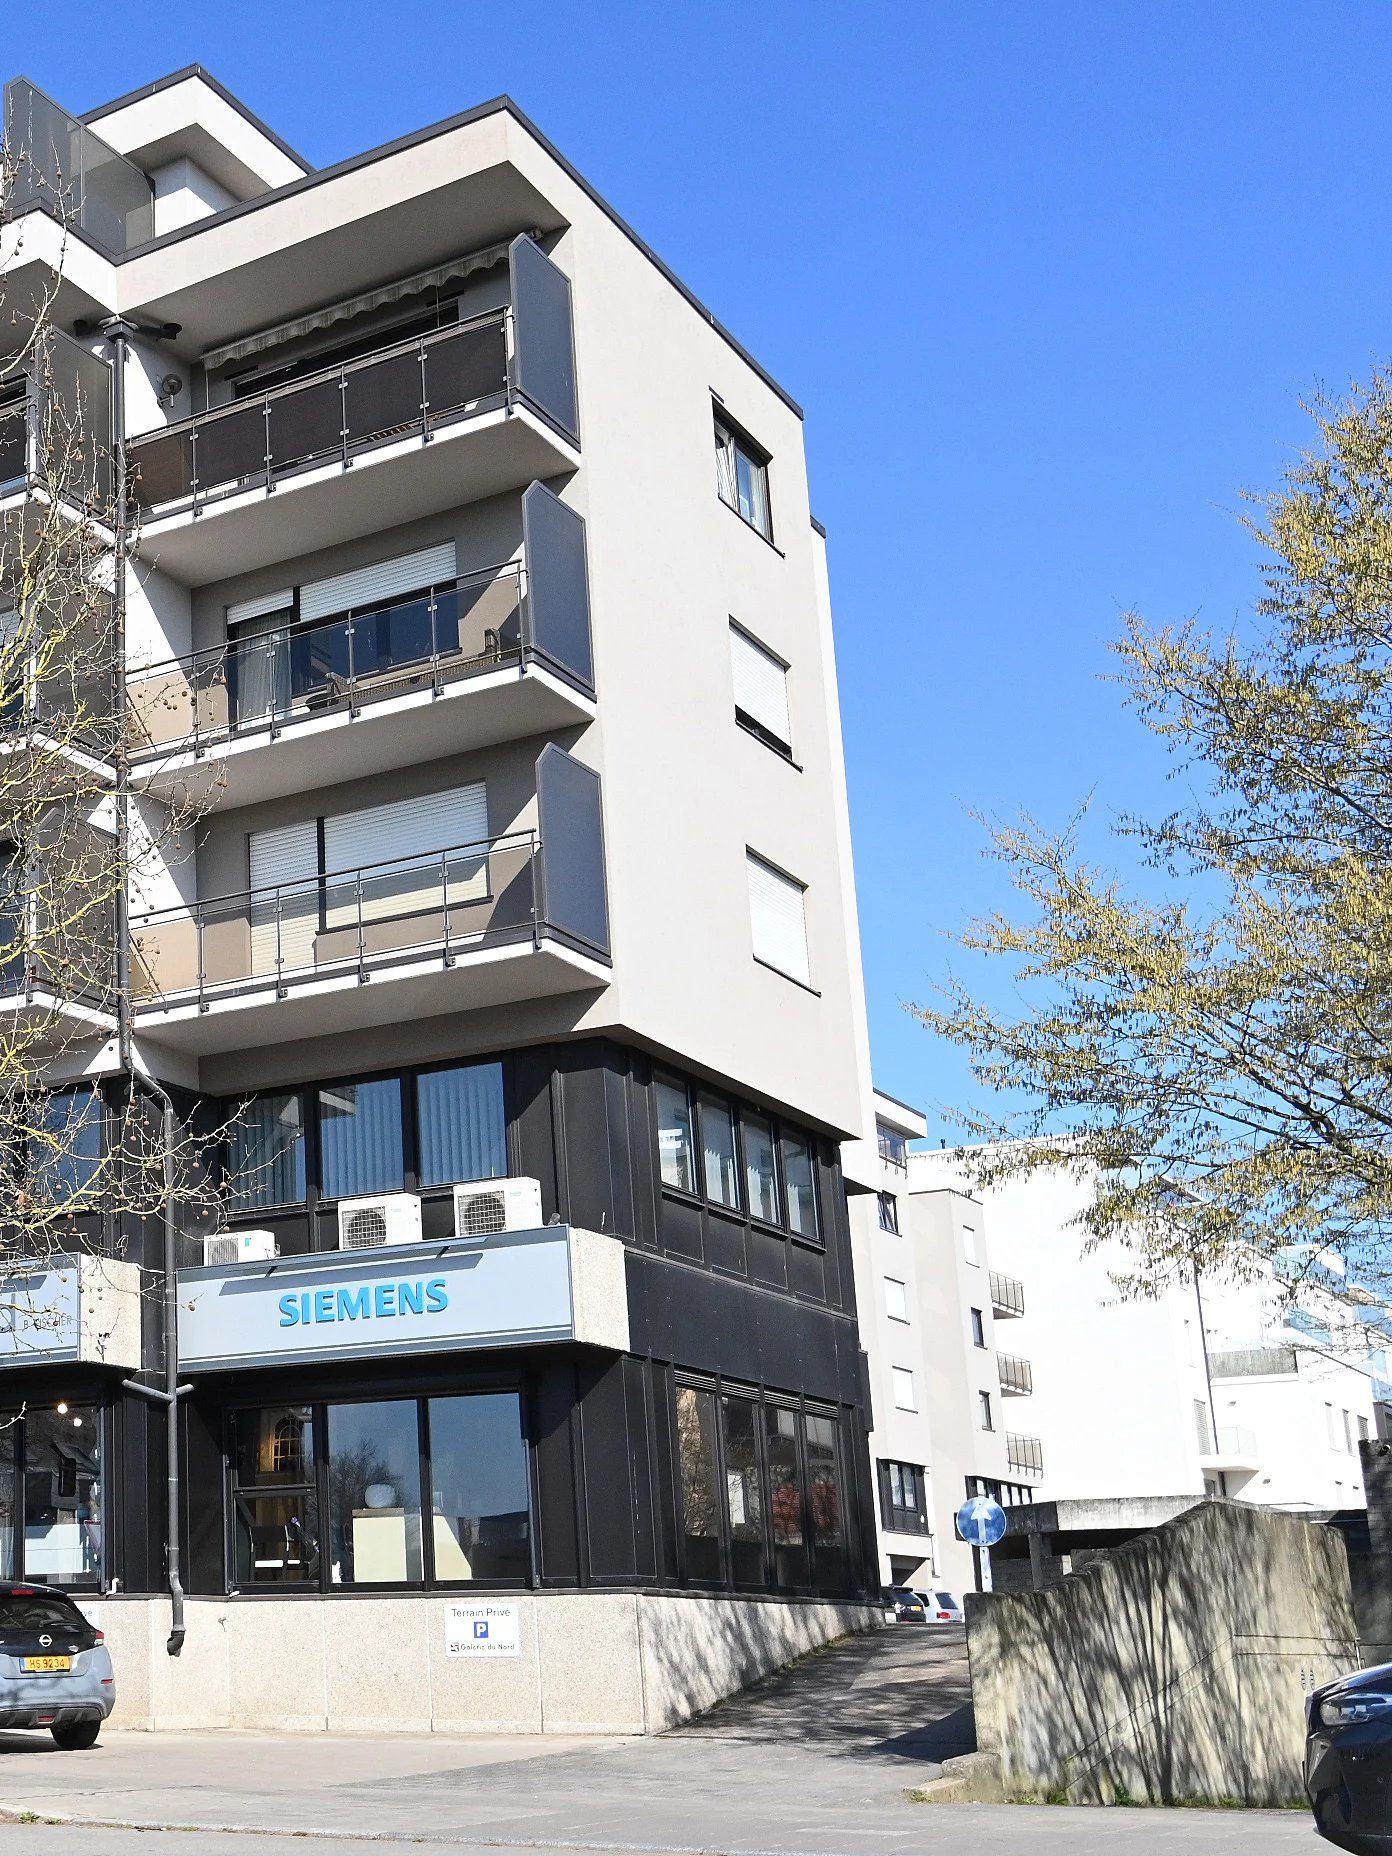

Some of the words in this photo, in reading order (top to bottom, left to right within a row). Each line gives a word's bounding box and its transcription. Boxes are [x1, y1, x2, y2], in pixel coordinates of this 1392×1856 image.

[279, 1278, 449, 1328] SIEMENS
[451, 1608, 484, 1617] Terrain
[476, 1622, 487, 1637] P
[461, 1643, 485, 1651] Galerie
[42, 1658, 65, 1668] 9234
